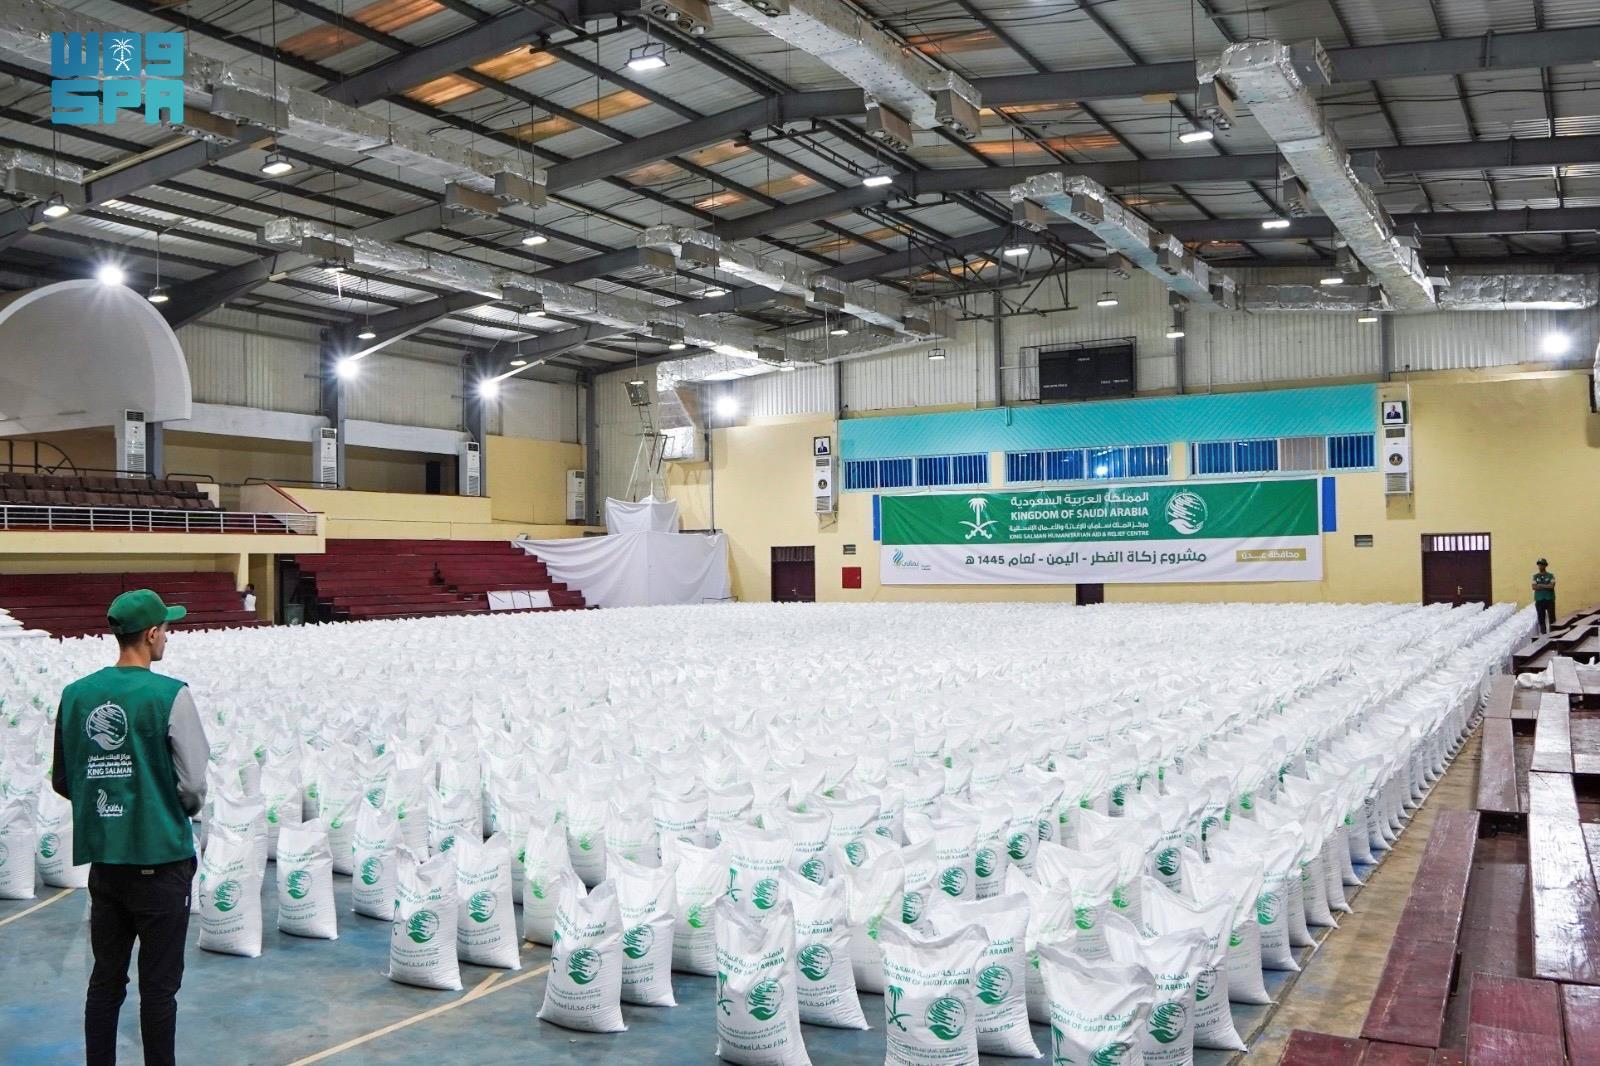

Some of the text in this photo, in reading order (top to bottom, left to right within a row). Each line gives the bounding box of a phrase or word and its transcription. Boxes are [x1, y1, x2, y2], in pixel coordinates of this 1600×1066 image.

[1010, 491, 1149, 509] المملكة العربية السعودية
[1010, 506, 1149, 521] KINGDOM OF SAUDI ARABIA
[977, 555, 1005, 565] 1445
[1008, 552, 1036, 567] لعام
[1046, 551, 1079, 567] اليمن
[1090, 550, 1123, 566] الفطر
[1126, 550, 1157, 565] زكاة
[1159, 547, 1207, 565] مشروع
[88, 766, 132, 776] KING SALMAN
[760, 956, 785, 969] ARABIA
[943, 978, 970, 986] ARABIA
